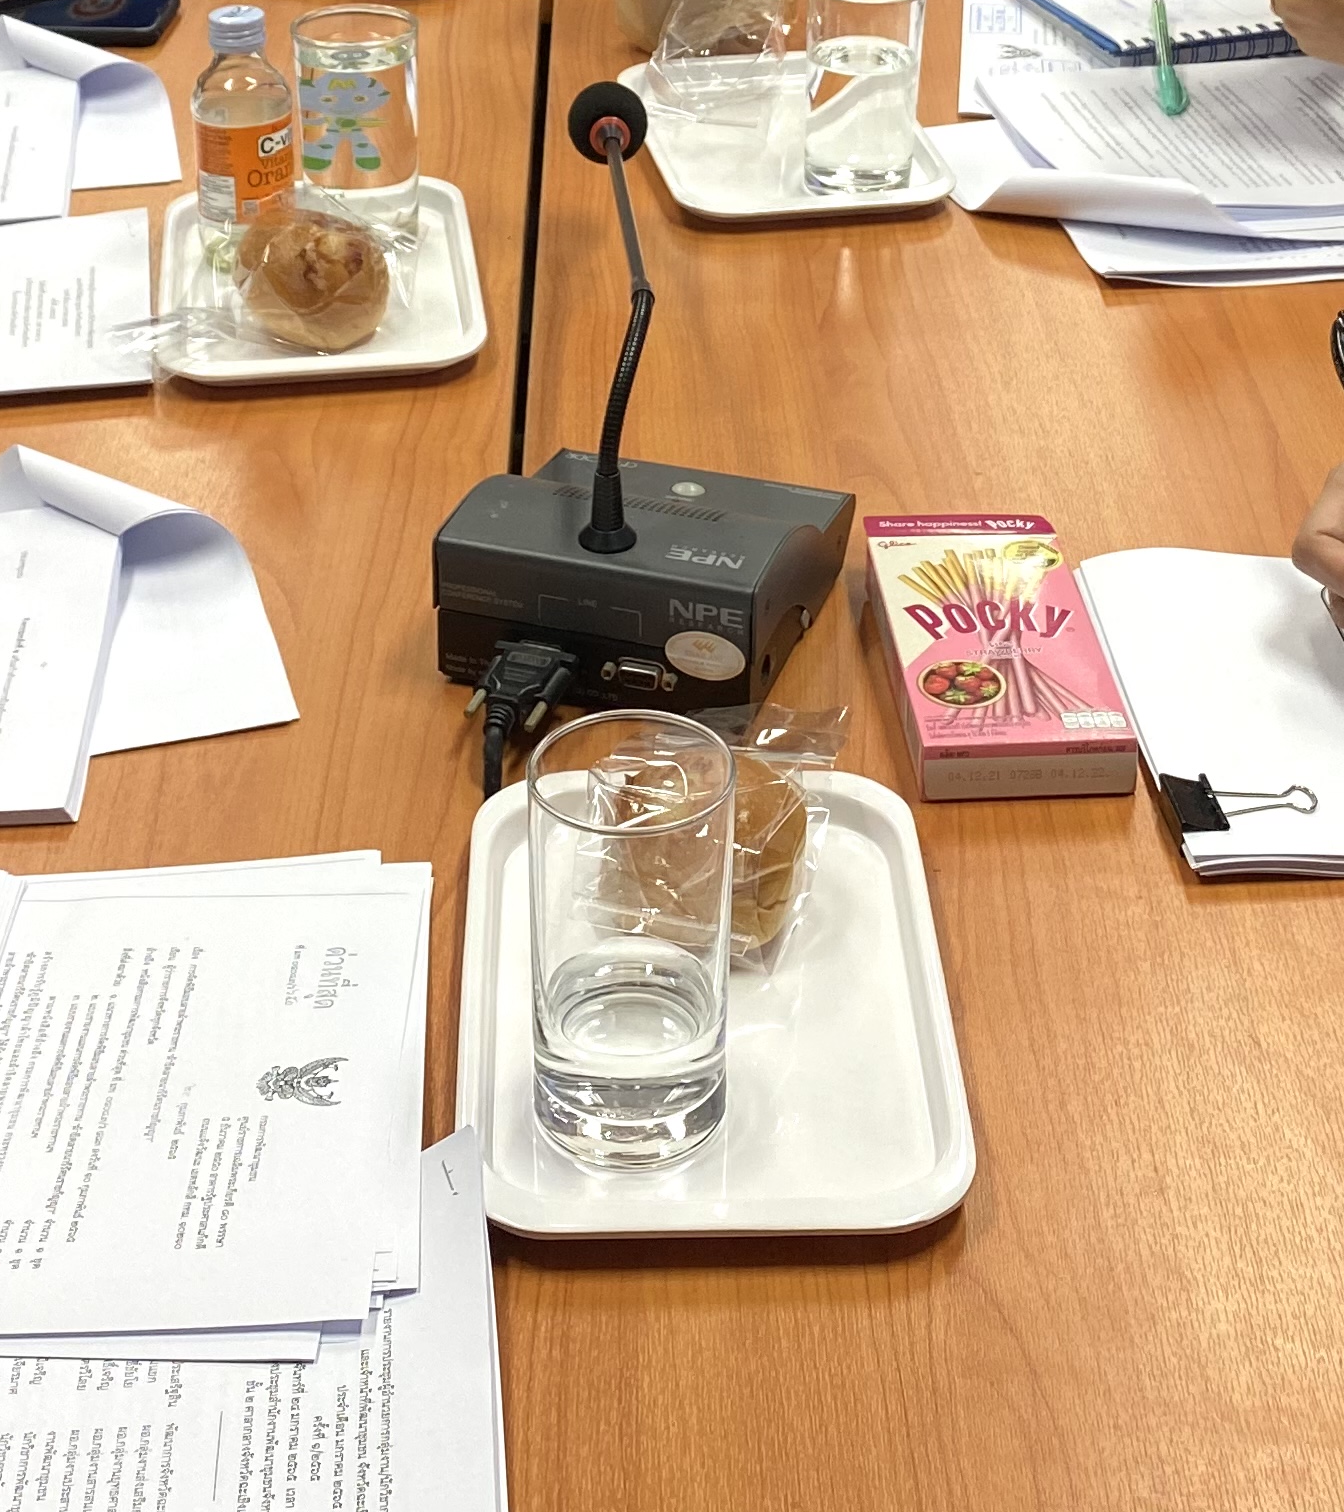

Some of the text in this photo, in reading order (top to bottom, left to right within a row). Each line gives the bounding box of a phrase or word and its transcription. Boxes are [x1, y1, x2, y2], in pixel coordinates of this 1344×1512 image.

[878, 520, 916, 529] Share
[917, 519, 982, 530] happiness!
[669, 598, 744, 629] NPE
[304, 946, 359, 1009] ด่วนที่สุด
[216, 1223, 228, 1248] พรรษา
[245, 1380, 264, 1393] ชั้น
[354, 1348, 375, 1459] และเจ้าหน้าที่พัฒนาชุมชน
[288, 1413, 300, 1451] มกราคม
[309, 1415, 330, 1483] ครั้งที่ ๑/๒๕๖๕
[332, 1384, 350, 1510] ประจำเดือน มกราคม ๒๕๖๕
[34, 1431, 58, 1502] งานพัฒนาชุมชน
[131, 1425, 153, 1512] ผอ.กลุ่มงานส่งเสริม
[156, 1423, 179, 1512] พัฒนาการจังหวัดฉะ
[286, 1453, 298, 1482] ๒๕๖๕
[285, 1487, 296, 1509] เวลา
